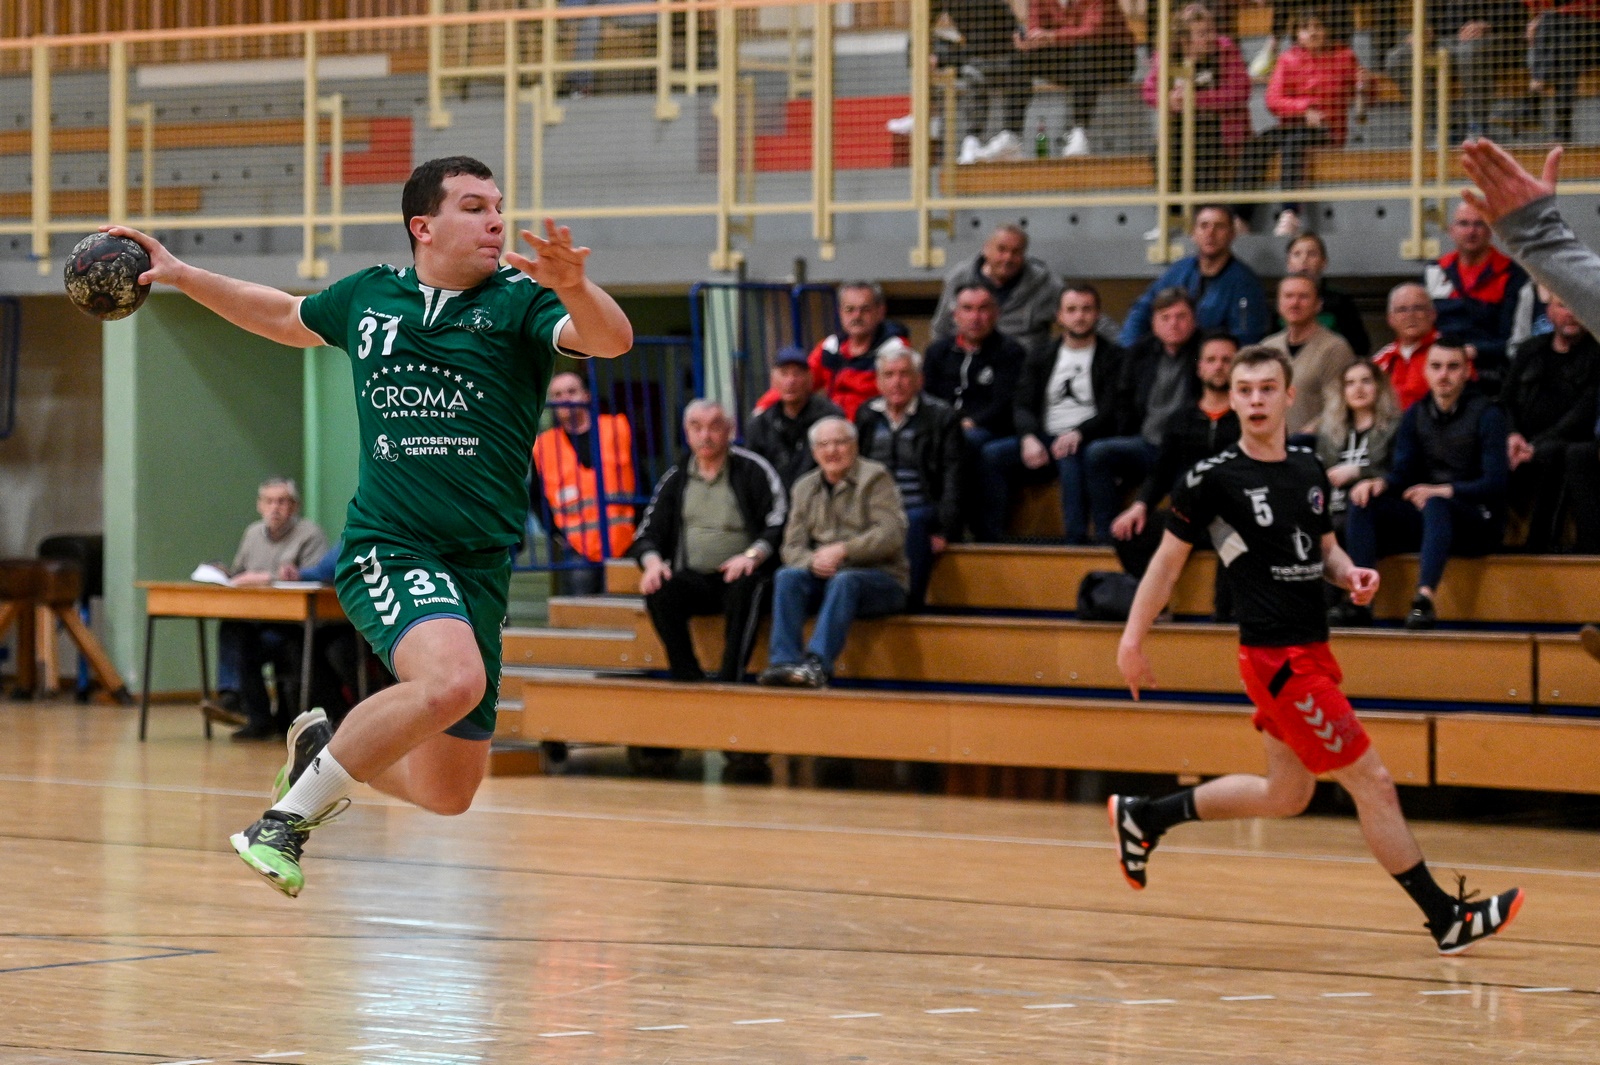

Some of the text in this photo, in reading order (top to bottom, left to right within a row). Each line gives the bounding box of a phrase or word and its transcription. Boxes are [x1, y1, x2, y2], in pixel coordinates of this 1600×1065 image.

[357, 316, 399, 360] 31
[371, 386, 468, 411] CROMA
[382, 409, 456, 419] VARAŽDIN
[400, 437, 480, 446] AUTOSERVISNI
[405, 447, 477, 456] CENTAR d.d.
[1250, 494, 1274, 527] 5
[403, 568, 460, 600] 31
[414, 597, 459, 607] hummel
